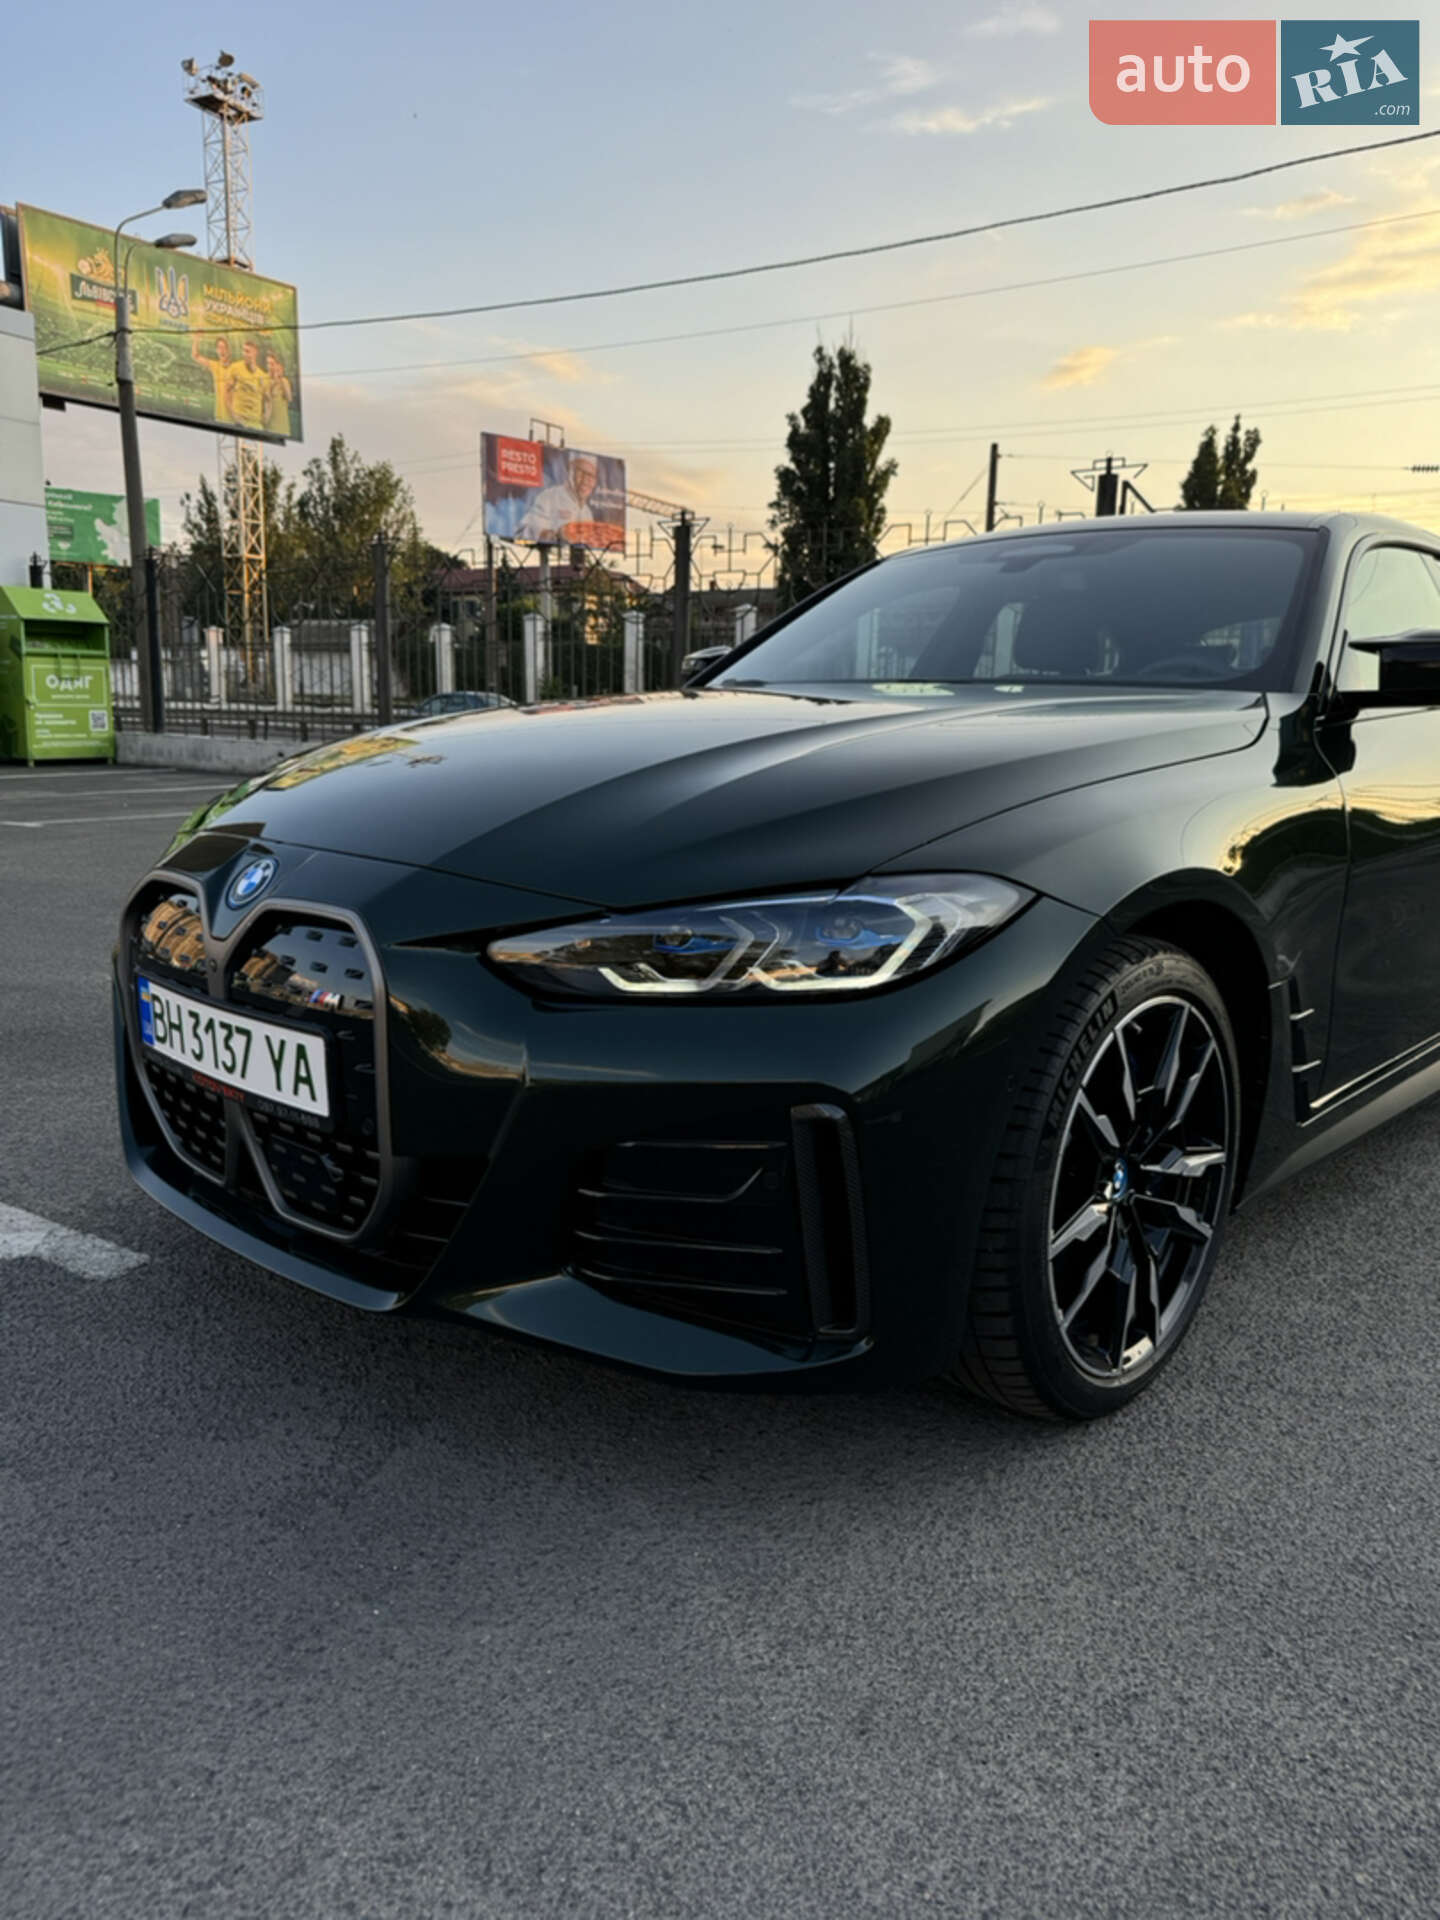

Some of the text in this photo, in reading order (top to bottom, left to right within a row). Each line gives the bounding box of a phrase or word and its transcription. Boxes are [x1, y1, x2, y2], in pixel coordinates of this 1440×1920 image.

[501, 449, 537, 465] RESTO
[501, 461, 537, 477] PRESTO
[151, 993, 186, 1054] BH
[188, 1009, 253, 1080] 3137
[264, 1034, 318, 1102] YA
[1046, 995, 1116, 1129] MICHELIN
